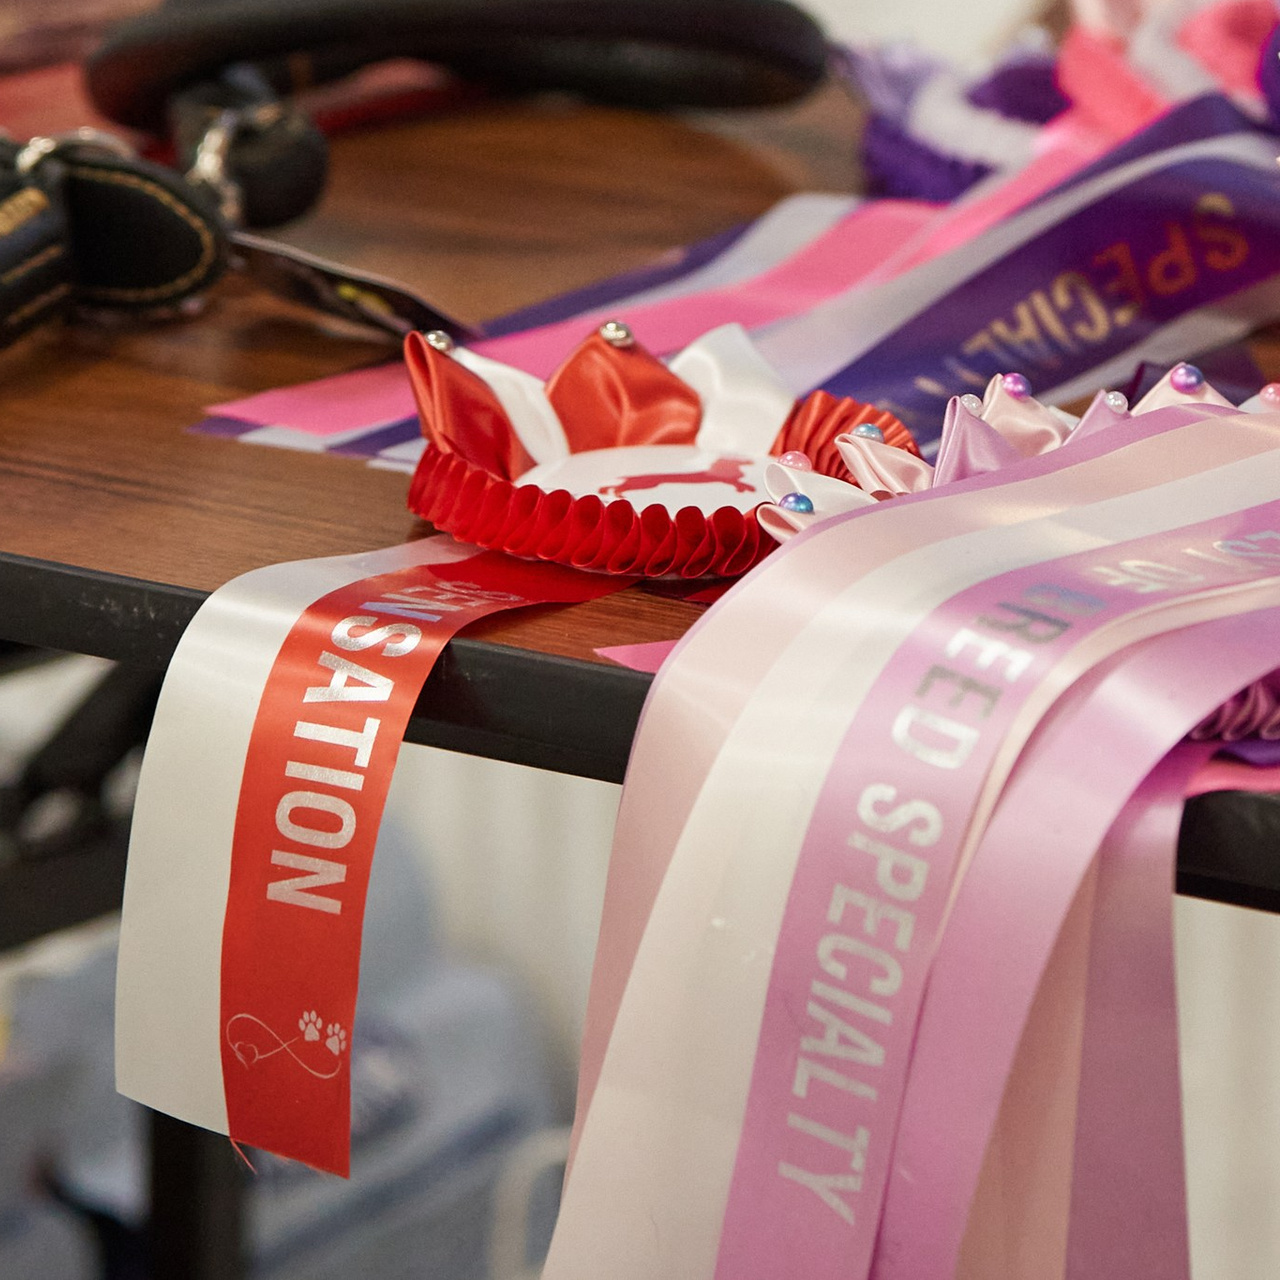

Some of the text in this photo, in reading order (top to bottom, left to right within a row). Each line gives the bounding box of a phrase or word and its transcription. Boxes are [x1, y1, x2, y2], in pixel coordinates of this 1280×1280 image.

[892, 583, 1108, 770] BREED
[1092, 558, 1204, 596] OF
[266, 581, 524, 915] SENSATION
[777, 782, 943, 1226] SPECIALTY
